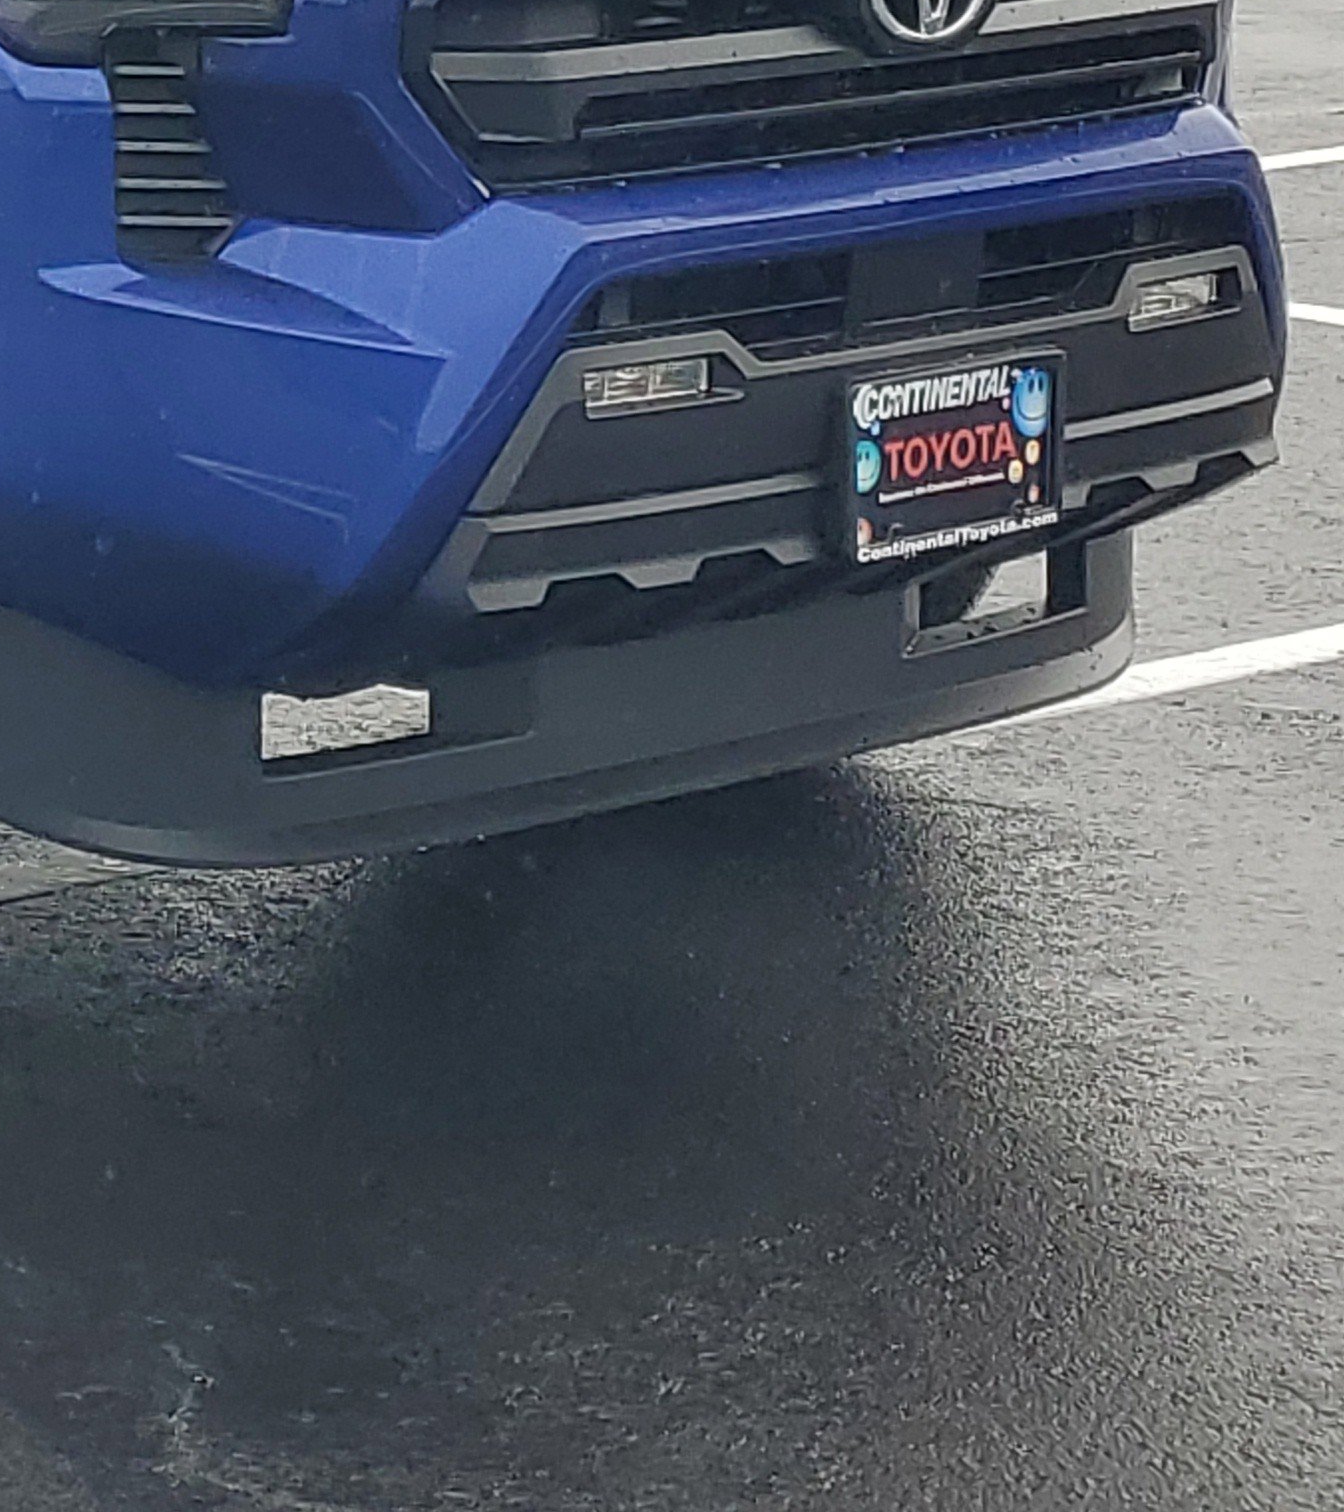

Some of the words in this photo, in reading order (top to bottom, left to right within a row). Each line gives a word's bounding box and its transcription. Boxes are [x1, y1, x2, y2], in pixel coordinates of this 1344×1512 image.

[853, 365, 1010, 430] CONTINENTAL
[884, 421, 1018, 481] TOYOTA
[857, 511, 1058, 563] ContinentalToyota.com
